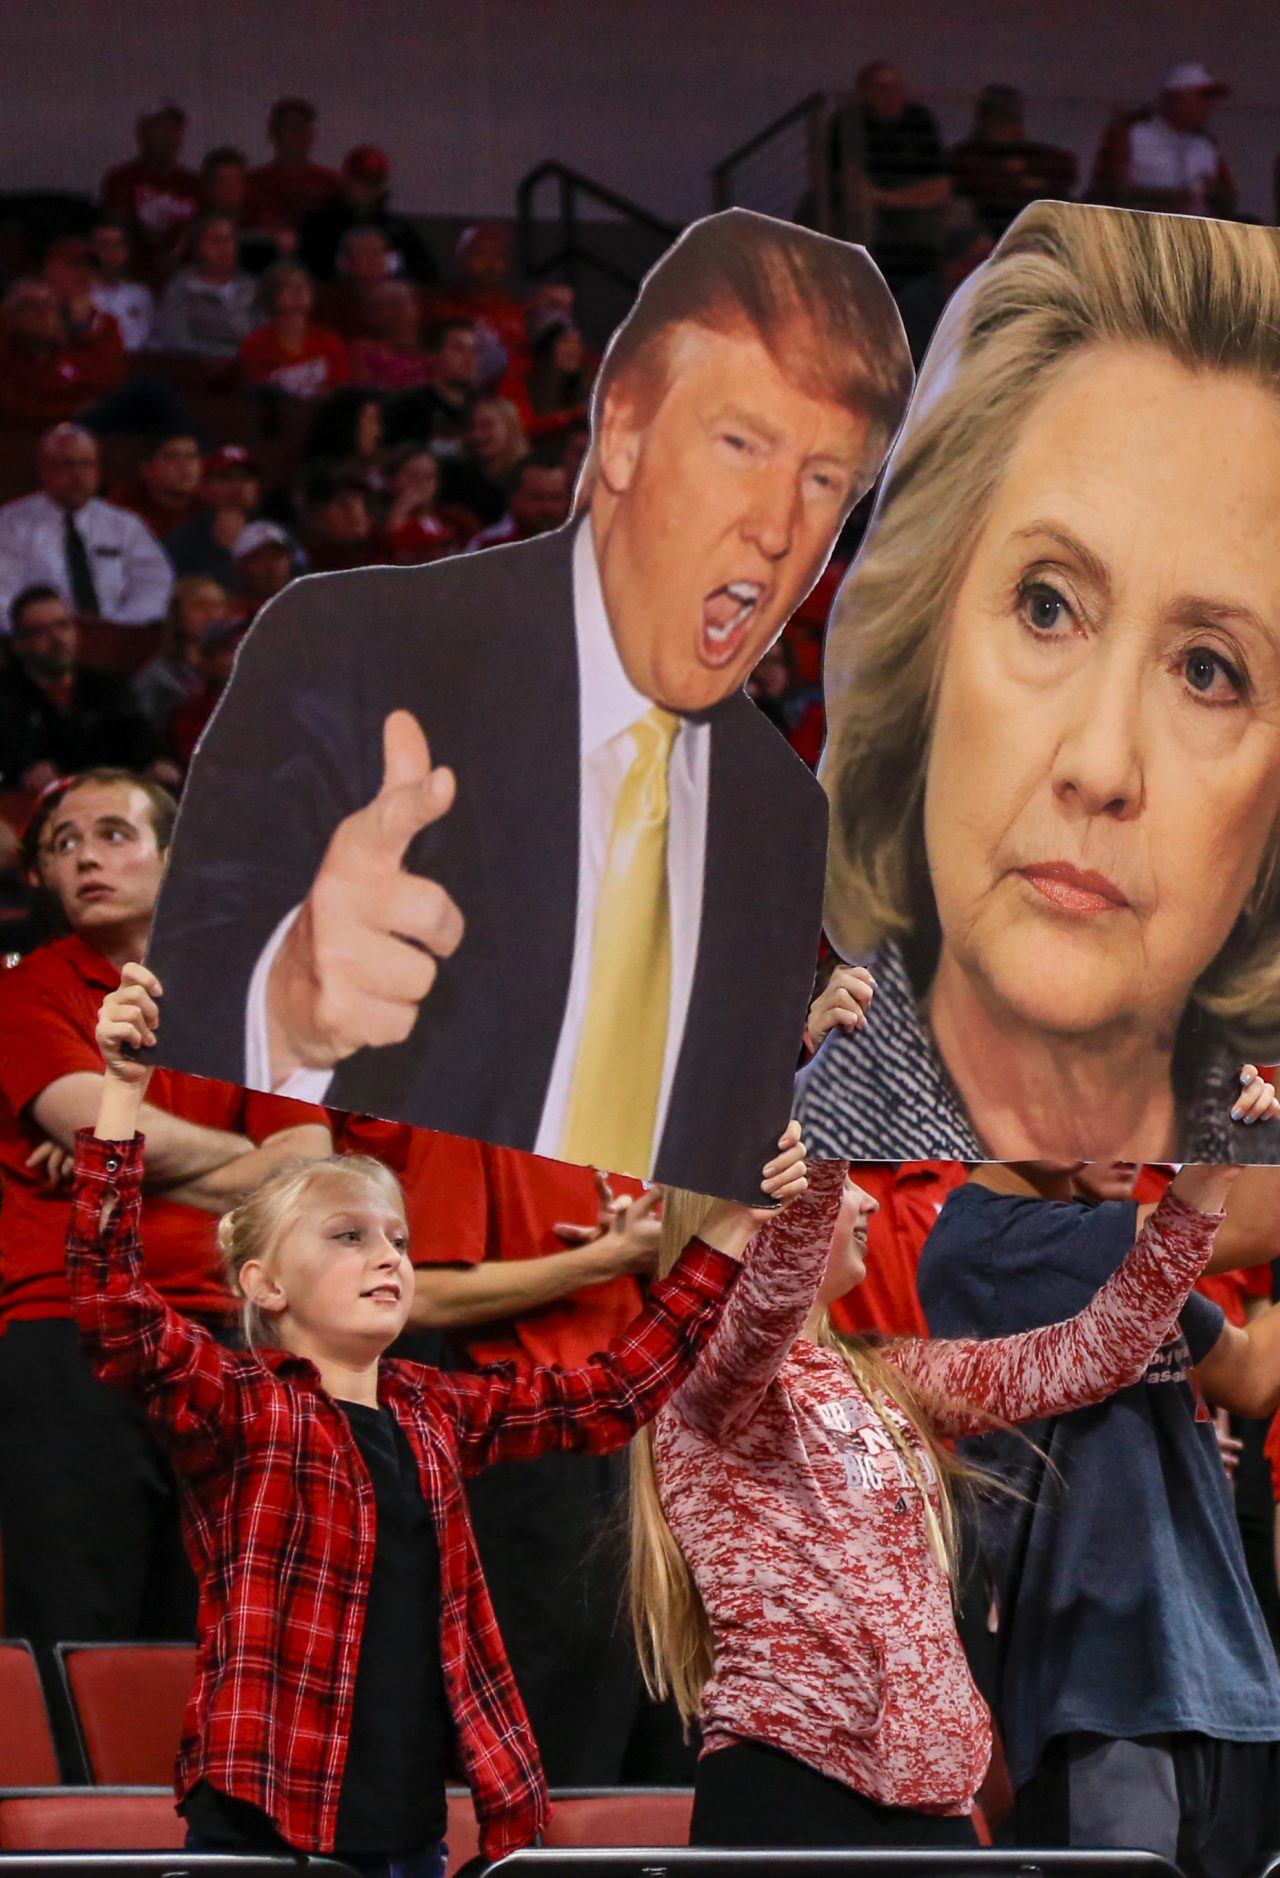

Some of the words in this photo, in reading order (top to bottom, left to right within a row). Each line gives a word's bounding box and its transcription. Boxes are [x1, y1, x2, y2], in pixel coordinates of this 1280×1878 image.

[857, 1424, 896, 1456] N
[840, 1452, 885, 1491] BIG
[893, 1449, 937, 1489] RD
